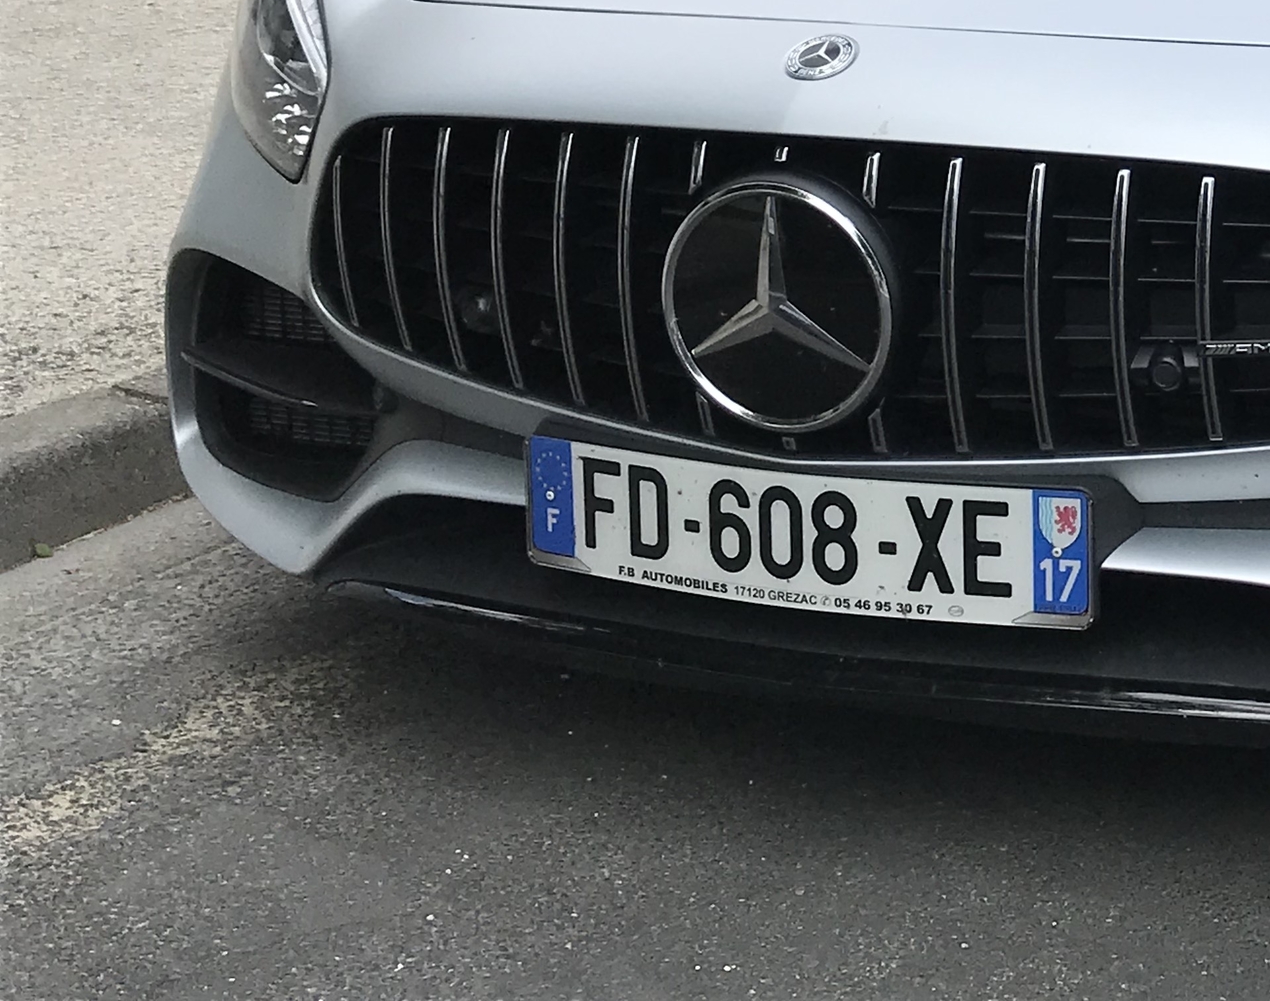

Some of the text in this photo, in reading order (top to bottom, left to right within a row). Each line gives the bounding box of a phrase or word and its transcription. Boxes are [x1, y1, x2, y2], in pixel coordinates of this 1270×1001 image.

[546, 508, 560, 533] F
[579, 456, 1012, 599] FD-608-XE
[641, 570, 728, 594] AUTOMOBILES
[734, 586, 765, 599] 17120
[768, 590, 818, 605] GREZAC
[834, 598, 850, 609] 05
[855, 599, 871, 611] 46
[875, 601, 892, 612] 95
[896, 603, 912, 614] 30
[916, 604, 933, 615] 67
[1039, 557, 1082, 603] 17
